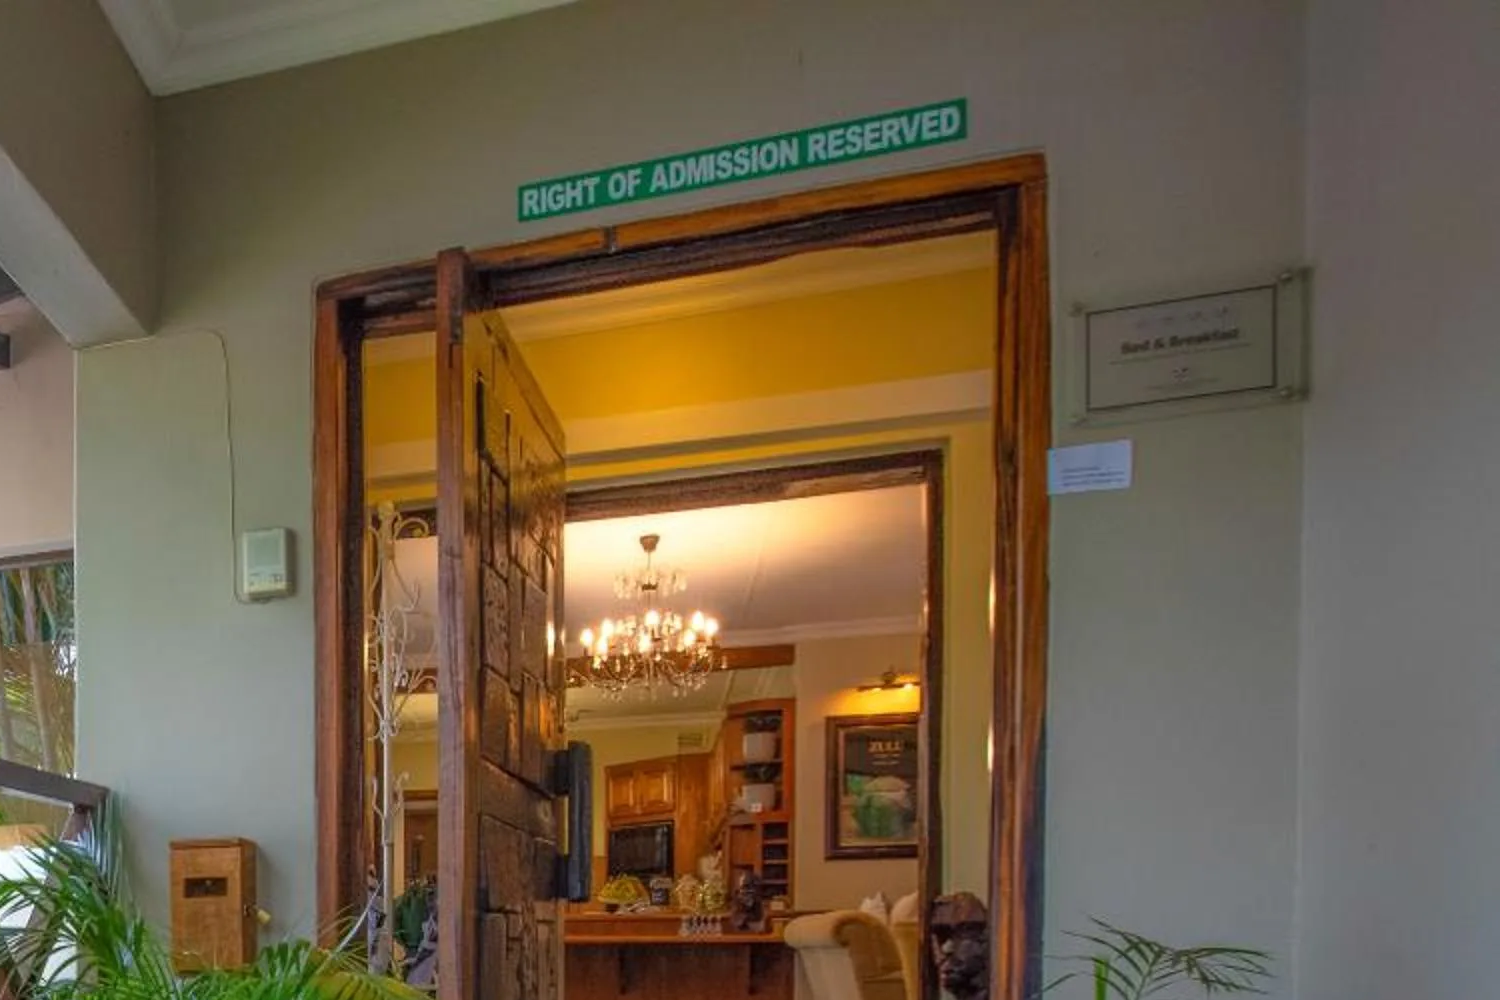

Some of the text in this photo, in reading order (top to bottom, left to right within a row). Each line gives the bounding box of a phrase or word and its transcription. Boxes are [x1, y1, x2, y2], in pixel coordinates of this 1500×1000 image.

[522, 106, 960, 216] RIGHT OF ADMISSION RESERVED
